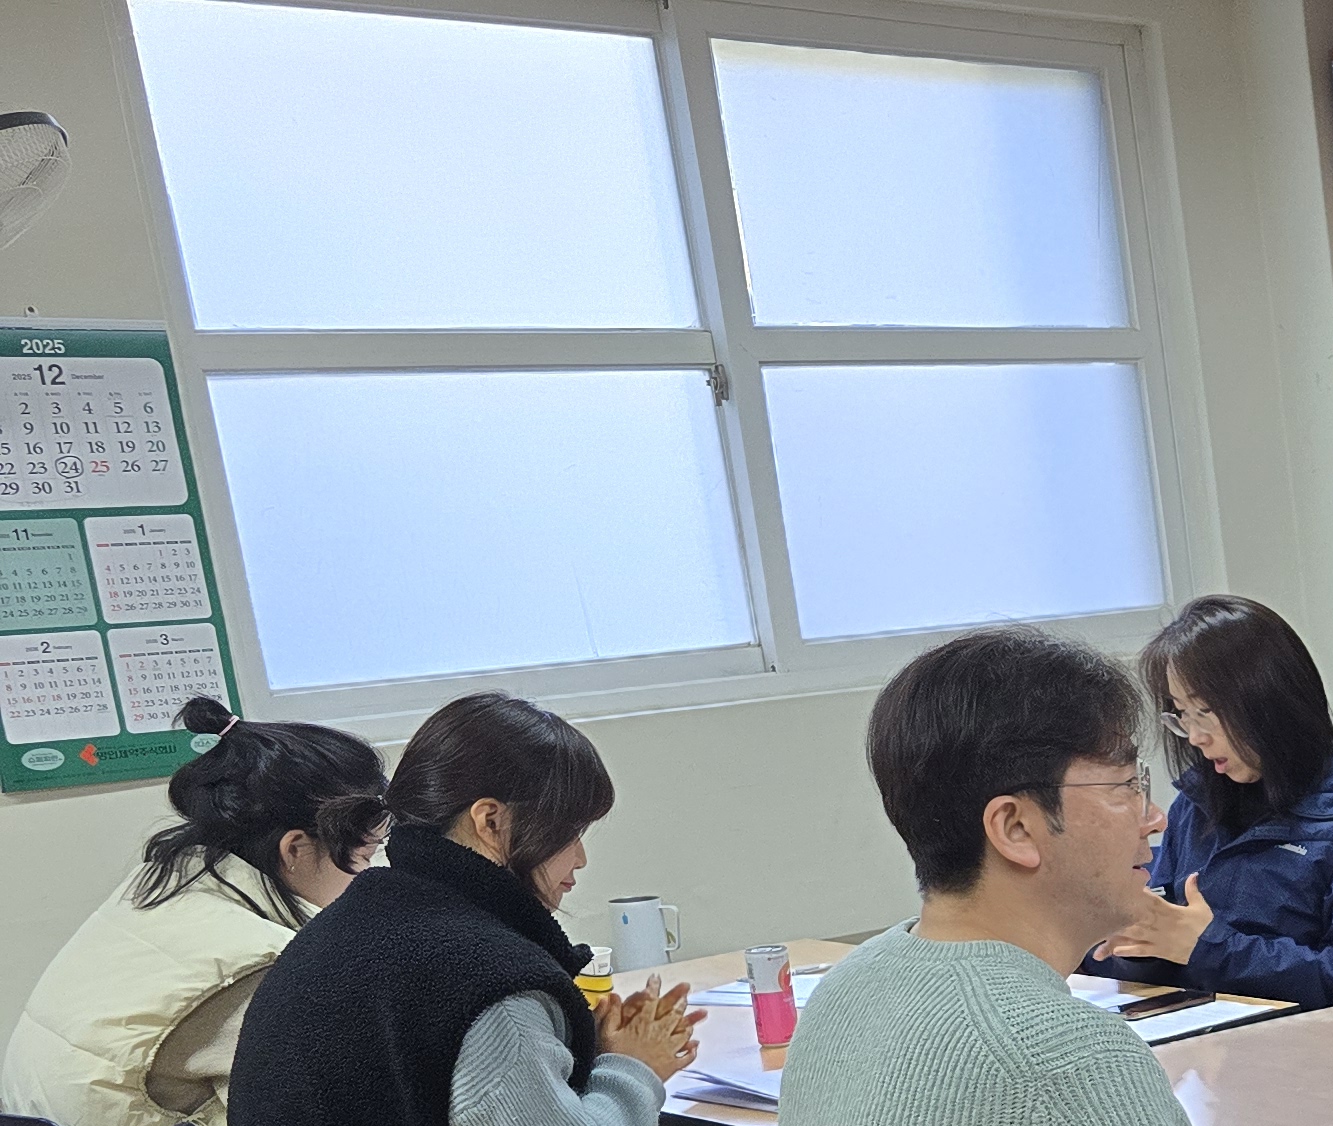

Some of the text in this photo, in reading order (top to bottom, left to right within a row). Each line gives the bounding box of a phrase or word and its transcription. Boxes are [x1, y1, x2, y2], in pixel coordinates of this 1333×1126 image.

[21, 340, 65, 354] 2025
[33, 364, 66, 385] 12
[20, 402, 154, 415] 2 3 4 5 6
[23, 421, 162, 435] 9 10 11 12 13
[0, 440, 166, 455] 5 16 17 18 19 20
[27, 462, 48, 475] 23
[58, 462, 80, 474] 24
[91, 461, 110, 473] 25
[120, 460, 141, 472] 26
[151, 460, 169, 472] 27
[1, 481, 82, 495] 29 30 31
[12, 529, 30, 541] 11
[138, 524, 146, 535] 1
[159, 633, 170, 645] 3
[40, 641, 52, 654] 2
